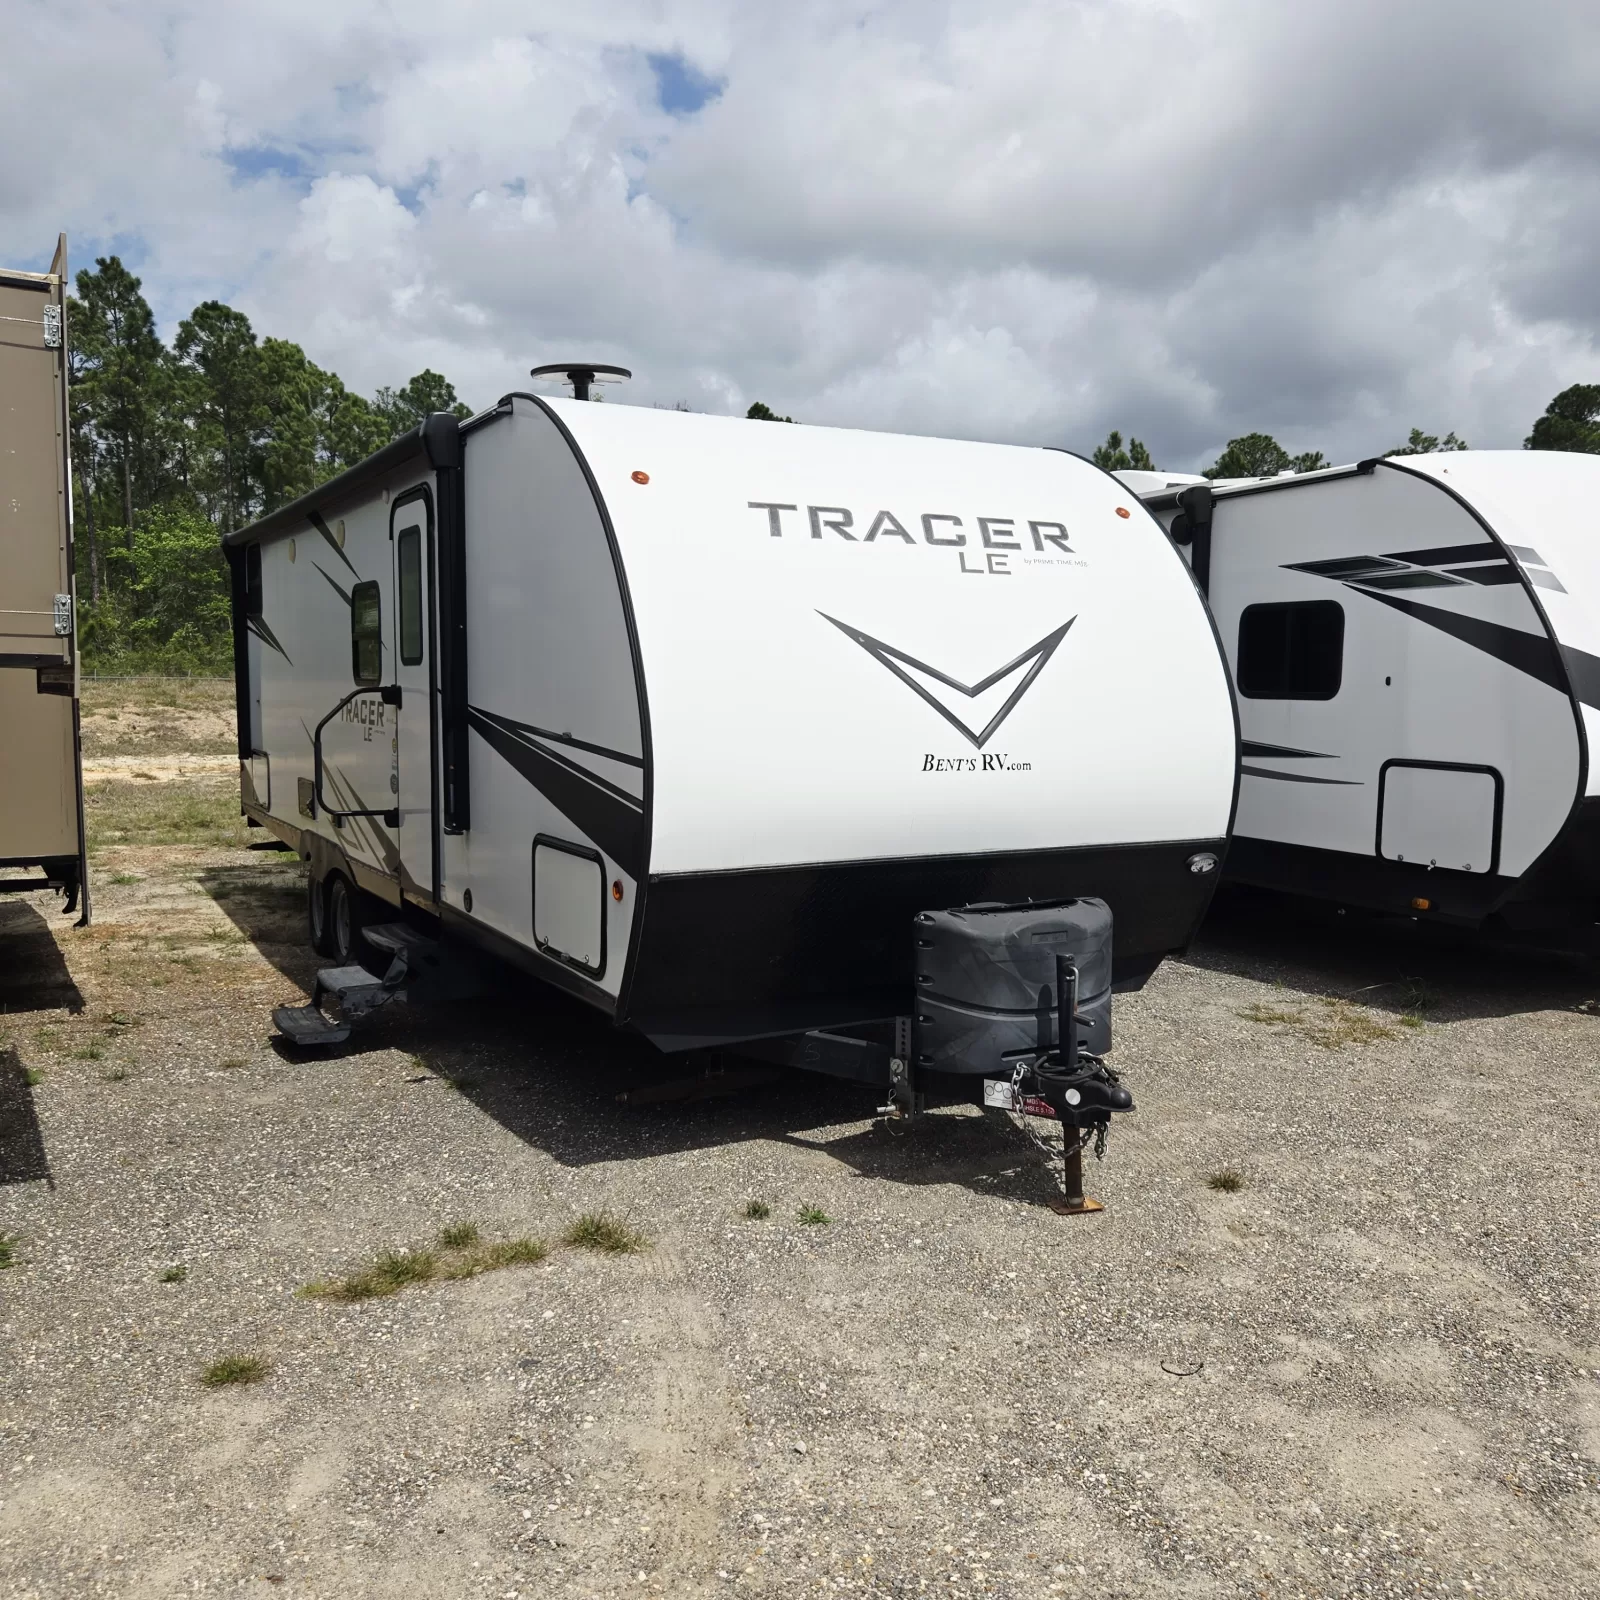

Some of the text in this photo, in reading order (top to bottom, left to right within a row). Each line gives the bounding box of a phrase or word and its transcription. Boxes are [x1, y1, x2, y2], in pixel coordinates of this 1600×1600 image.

[747, 501, 1076, 554] TRACER
[958, 552, 1012, 576] LE
[1024, 558, 1032, 566] by
[364, 727, 372, 742] LE
[921, 753, 977, 772] BENT'S
